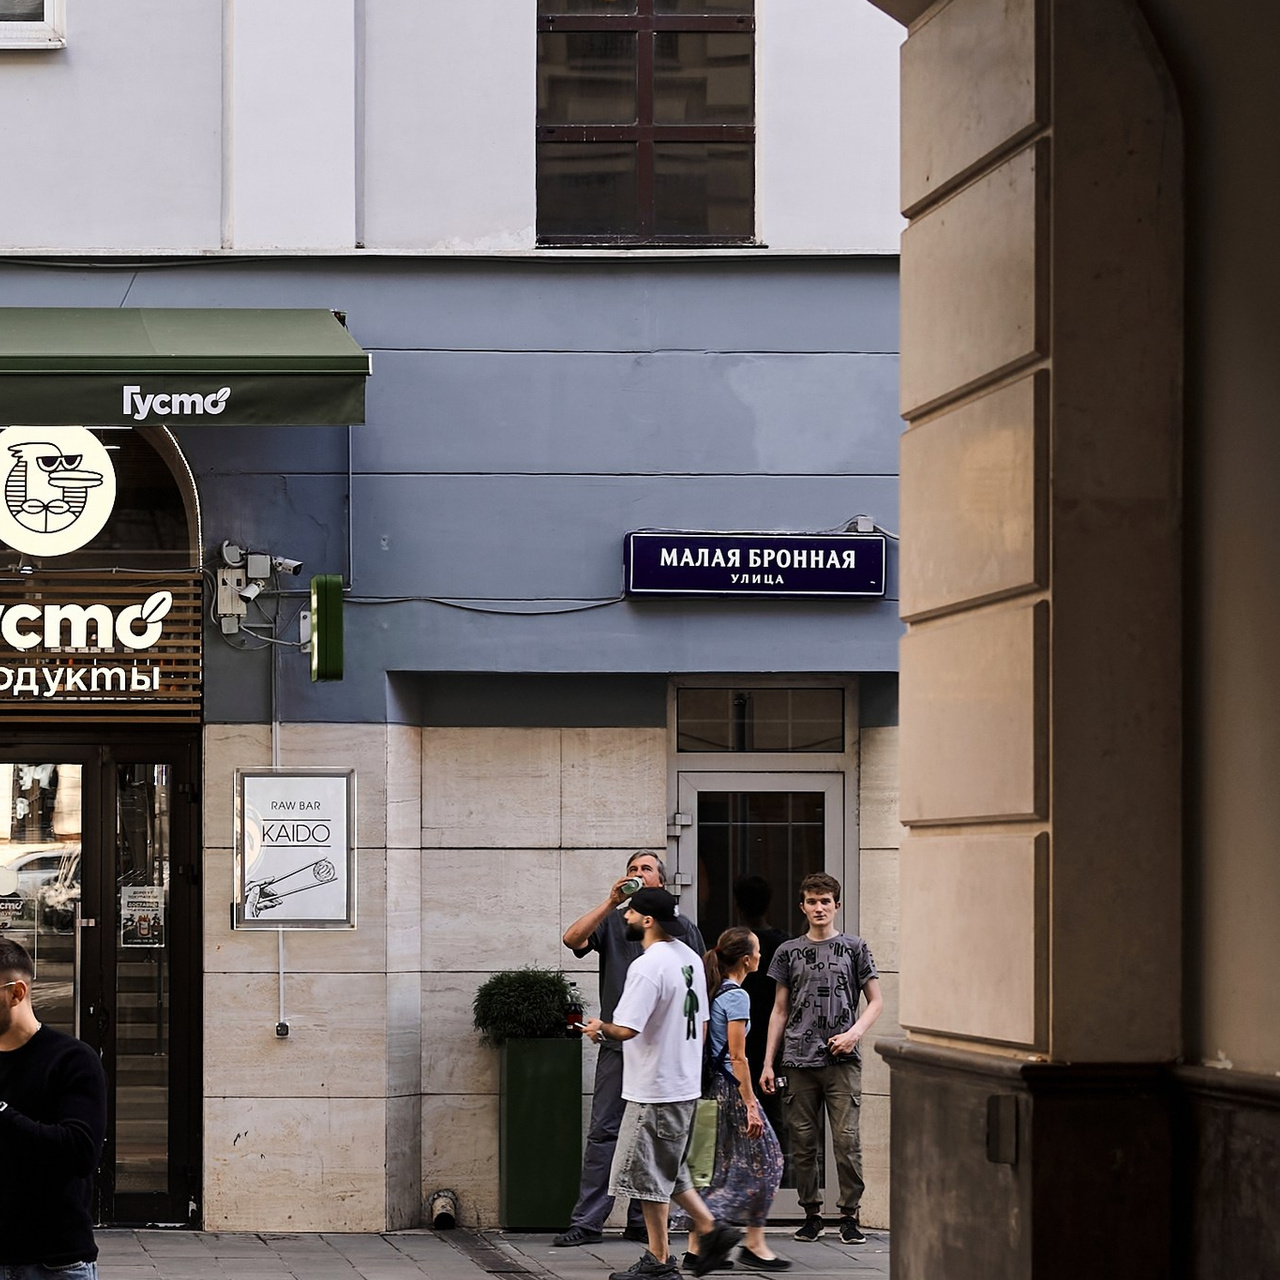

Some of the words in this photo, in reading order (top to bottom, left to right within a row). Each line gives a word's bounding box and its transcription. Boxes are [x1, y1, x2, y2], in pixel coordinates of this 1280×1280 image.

[122, 385, 231, 420] Густо
[660, 547, 741, 568] МАЛАЯ
[748, 548, 856, 569] БРОННАЯ
[730, 573, 785, 585] УЛИЦА
[271, 801, 296, 810] RAW
[299, 801, 321, 810] BAR
[262, 823, 331, 843] KAIDO
